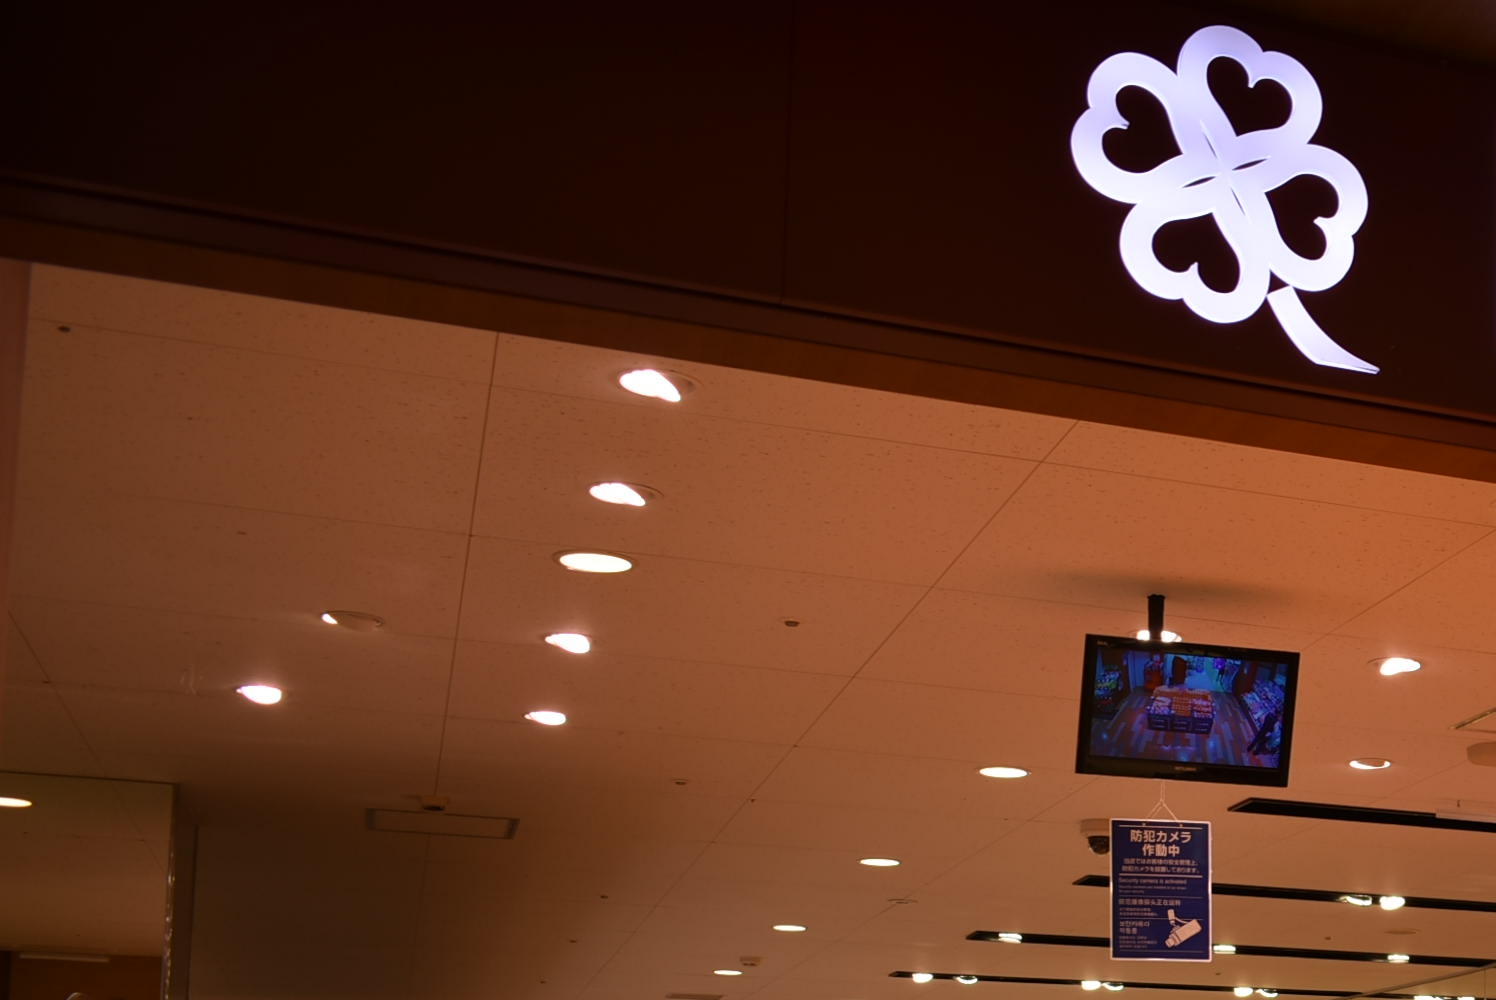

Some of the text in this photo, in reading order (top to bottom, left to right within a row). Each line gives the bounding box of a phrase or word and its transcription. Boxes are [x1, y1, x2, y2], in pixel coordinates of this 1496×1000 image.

[1130, 829, 1192, 843] 防犯カメラ
[1142, 843, 1180, 857] 作動中
